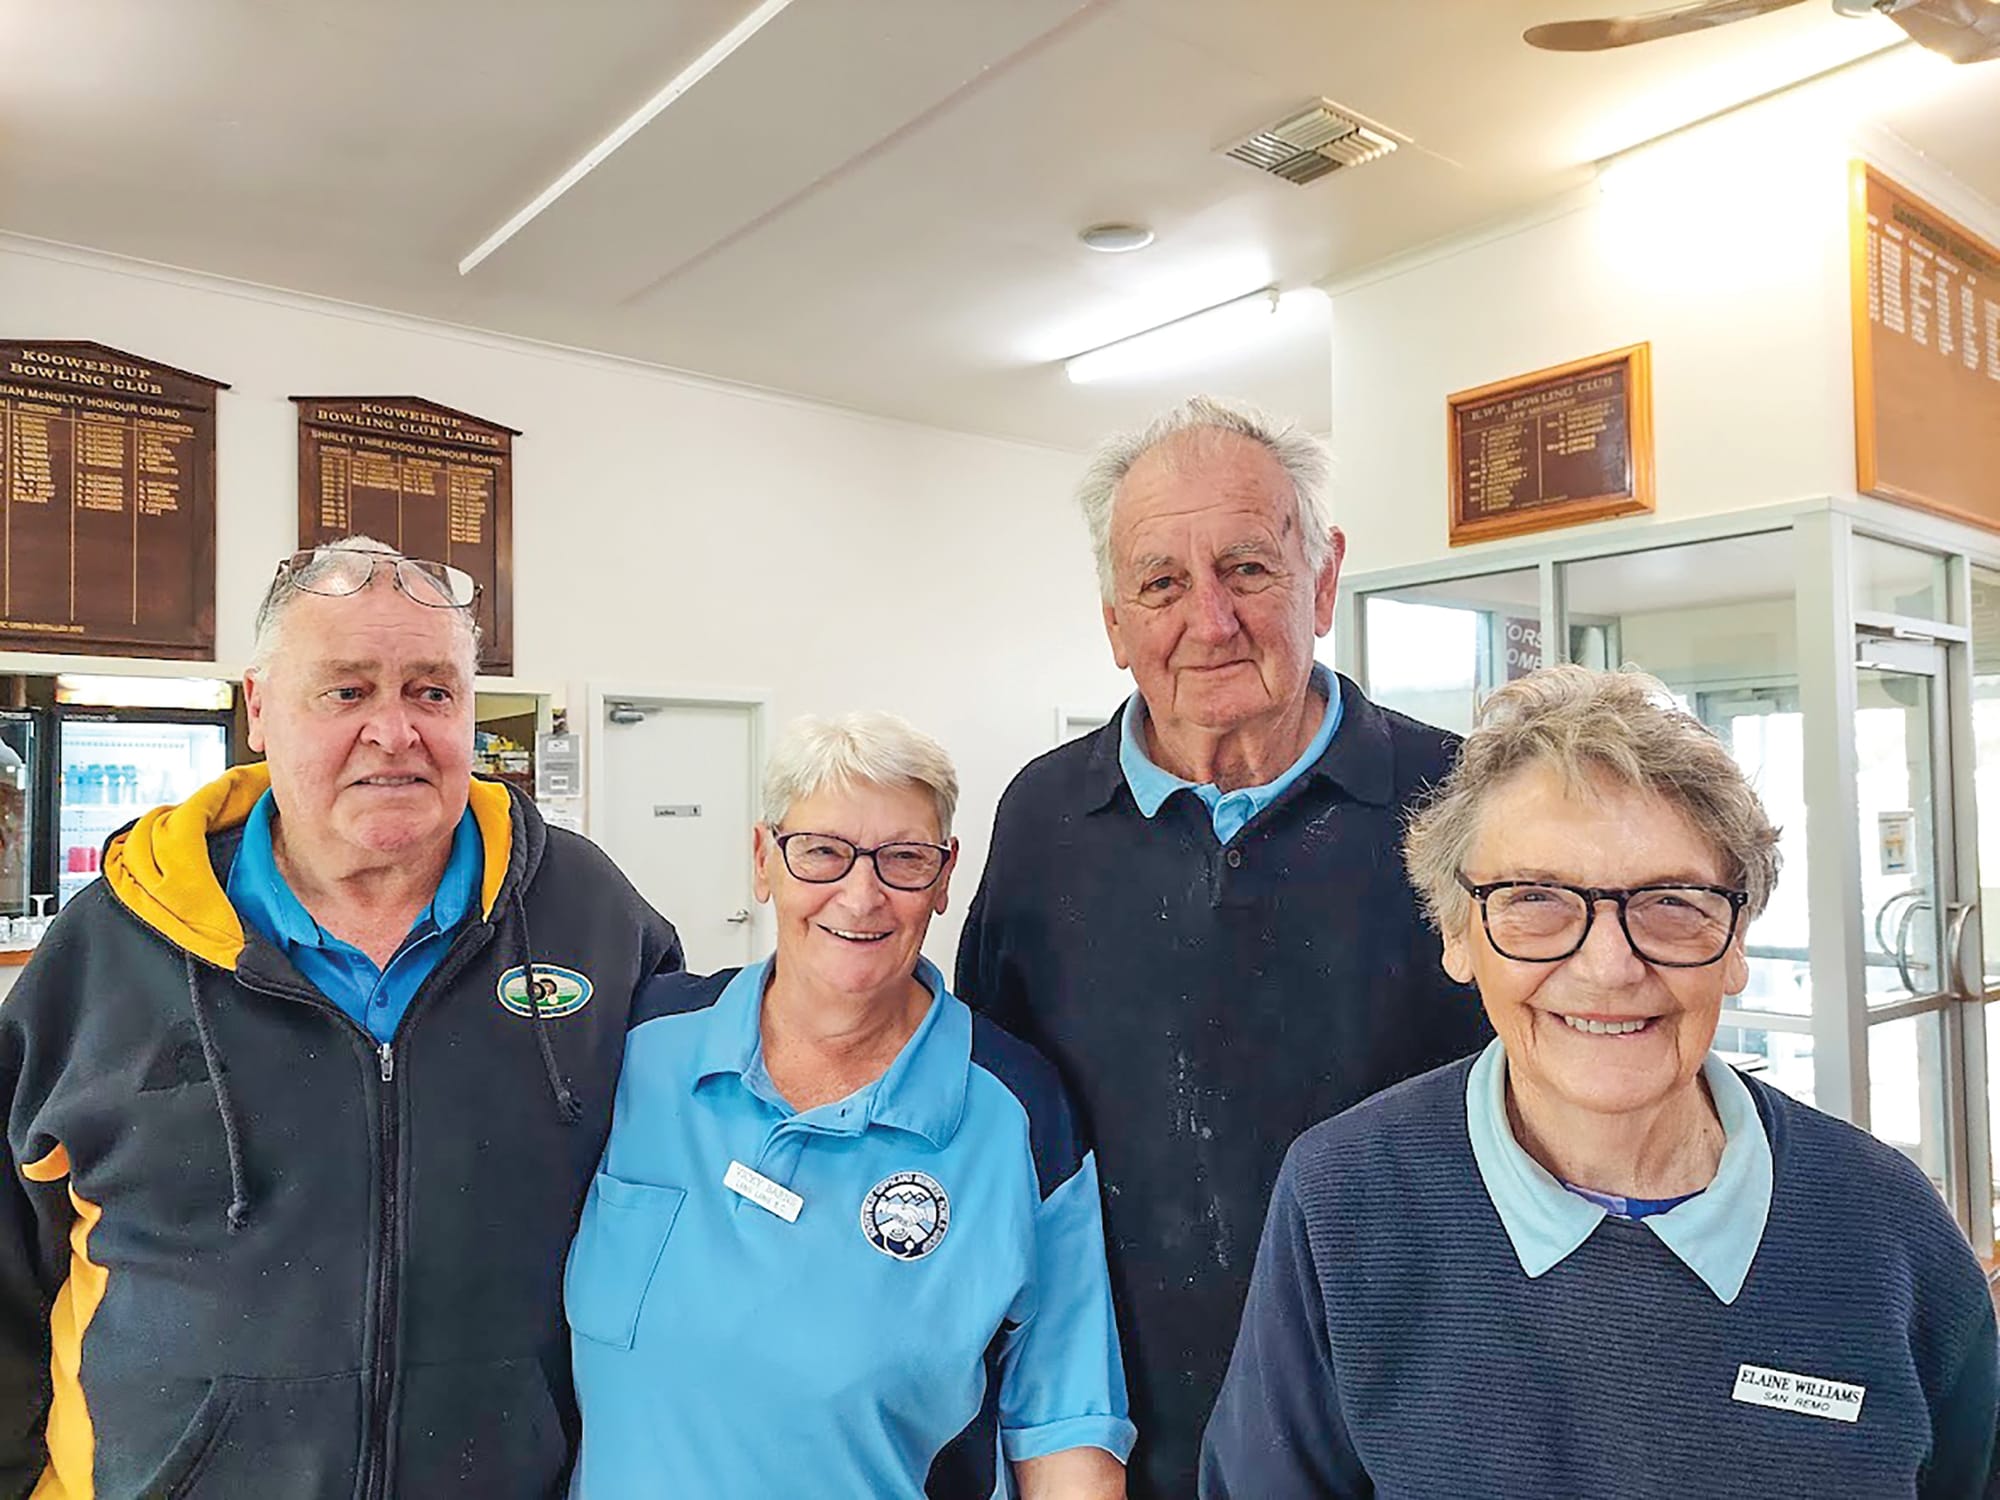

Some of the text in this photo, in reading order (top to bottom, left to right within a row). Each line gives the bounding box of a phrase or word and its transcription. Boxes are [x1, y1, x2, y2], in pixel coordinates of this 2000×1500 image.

[11, 363, 163, 394] BOWLING CLUB
[22, 349, 151, 378] KOOWEERUP
[28, 388, 83, 404] McNULTY
[87, 397, 138, 412] HONOUR
[140, 405, 180, 419] BOARD
[1512, 386, 1573, 410] BOWLING
[1577, 376, 1613, 393] CLUB
[317, 410, 499, 446] BOWLING CLUB LADIES
[361, 402, 461, 427] KOOWEERUP
[311, 430, 502, 466] SHIRLEY THREADGOLD HONOUR BOARD
[1506, 622, 1543, 648] ORS
[1740, 1369, 1861, 1404] ELAINE WILLIAMS
[1763, 1391, 1831, 1412] SAN REMO
